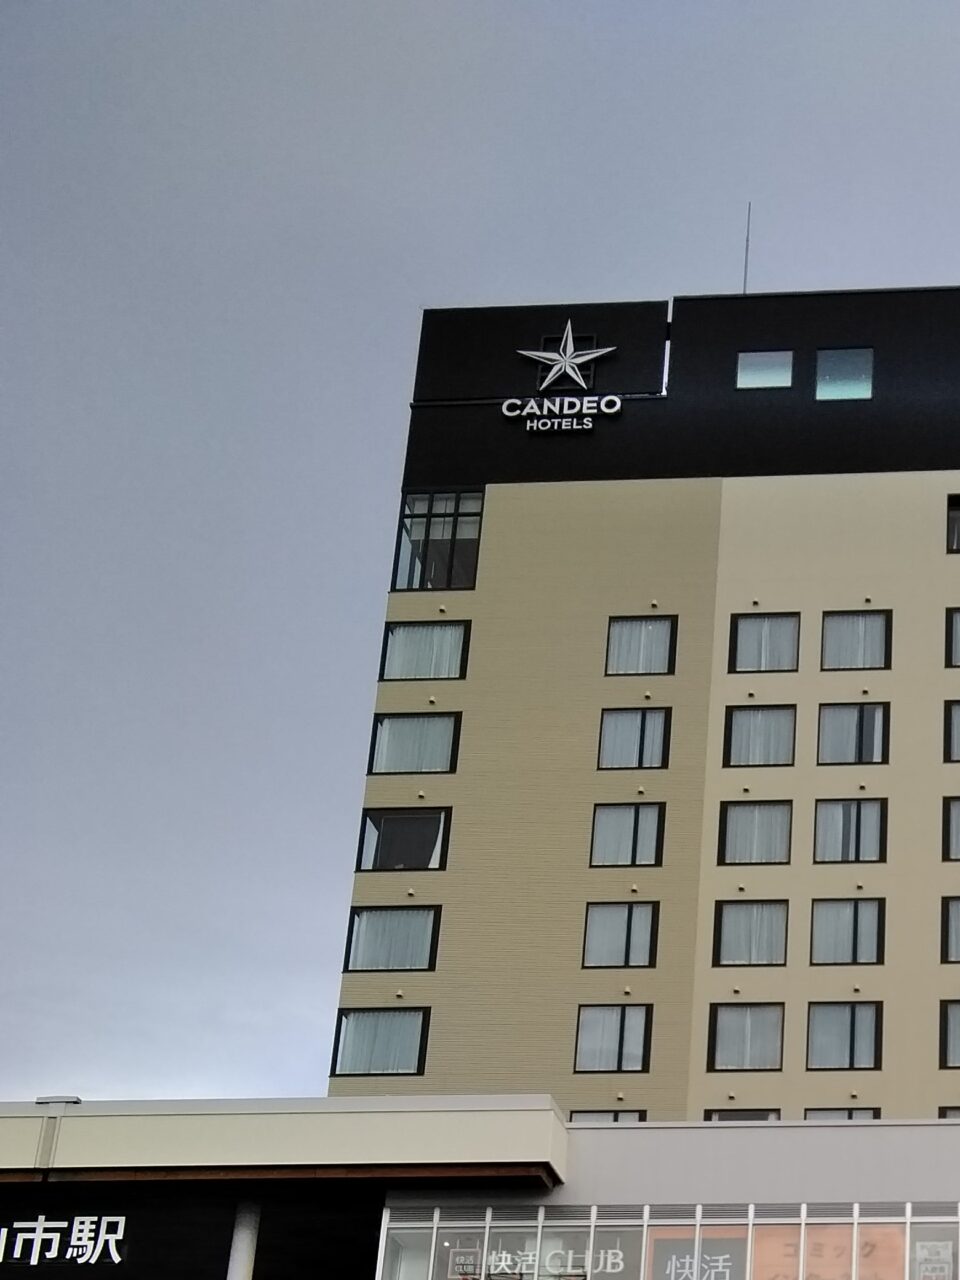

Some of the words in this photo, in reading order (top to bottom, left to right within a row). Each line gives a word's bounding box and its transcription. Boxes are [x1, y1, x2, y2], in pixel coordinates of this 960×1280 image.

[501, 395, 622, 417] CANDEO
[526, 417, 593, 431] HOTELS
[0, 1215, 126, 1266] 市駅
